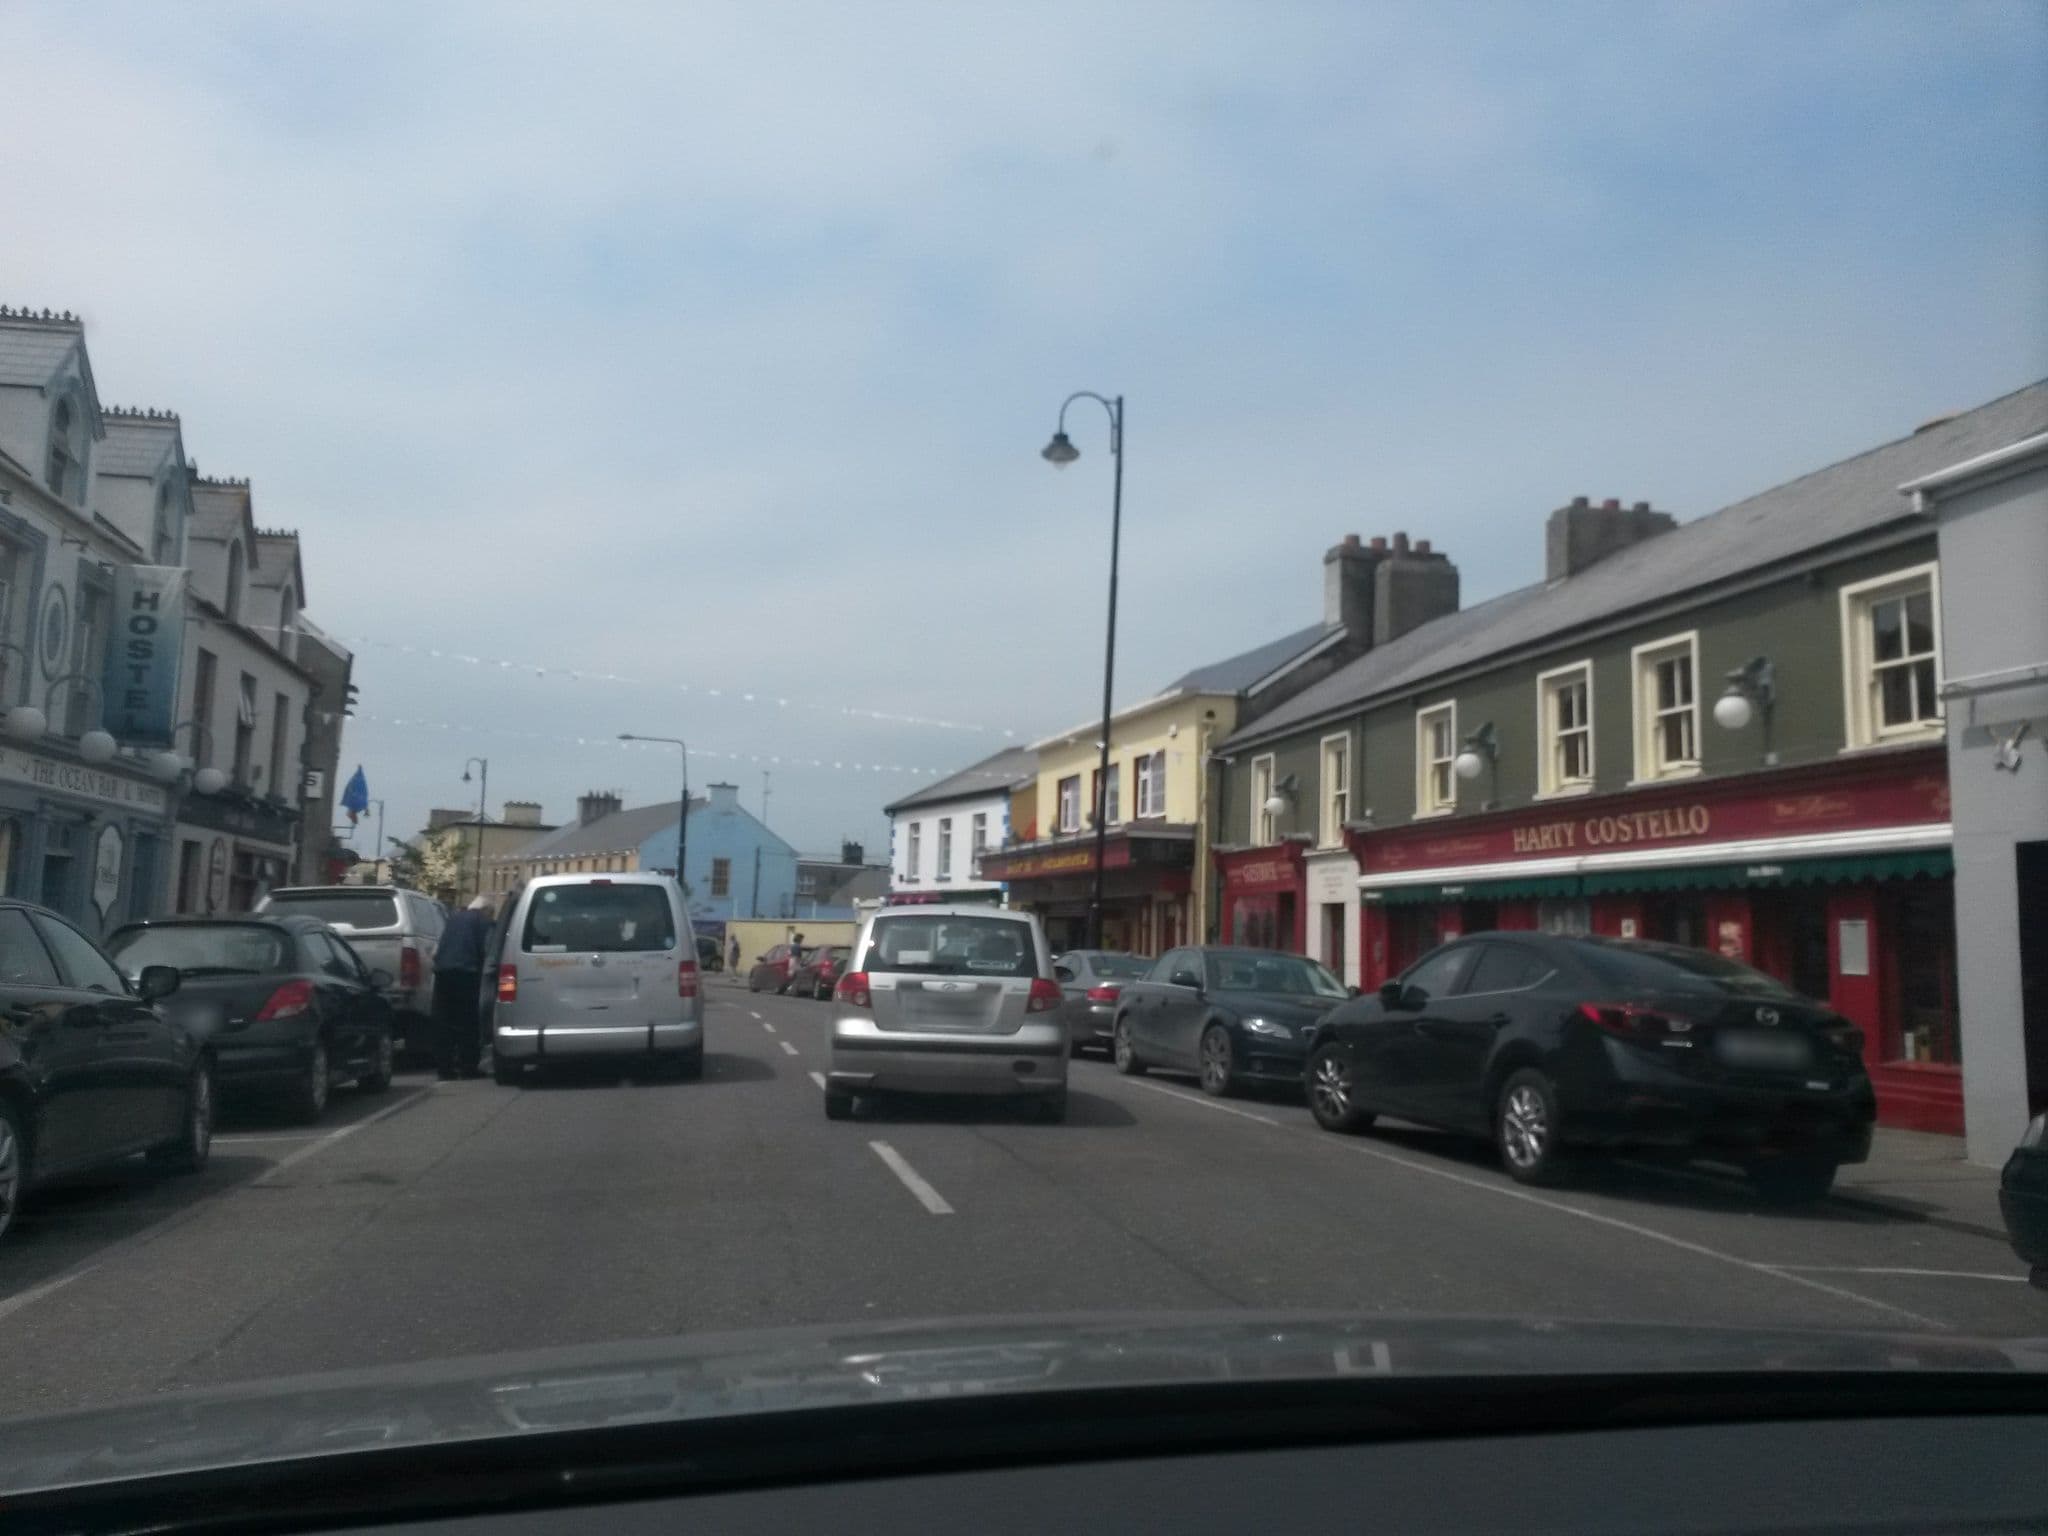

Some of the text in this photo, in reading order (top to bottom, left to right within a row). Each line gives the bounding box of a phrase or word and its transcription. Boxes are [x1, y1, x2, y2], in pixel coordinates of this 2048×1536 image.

[124, 591, 160, 735] HOSTEL
[33, 759, 54, 784] THE
[1512, 822, 1576, 852] HARTY
[1584, 805, 1710, 845] COSTELLO
